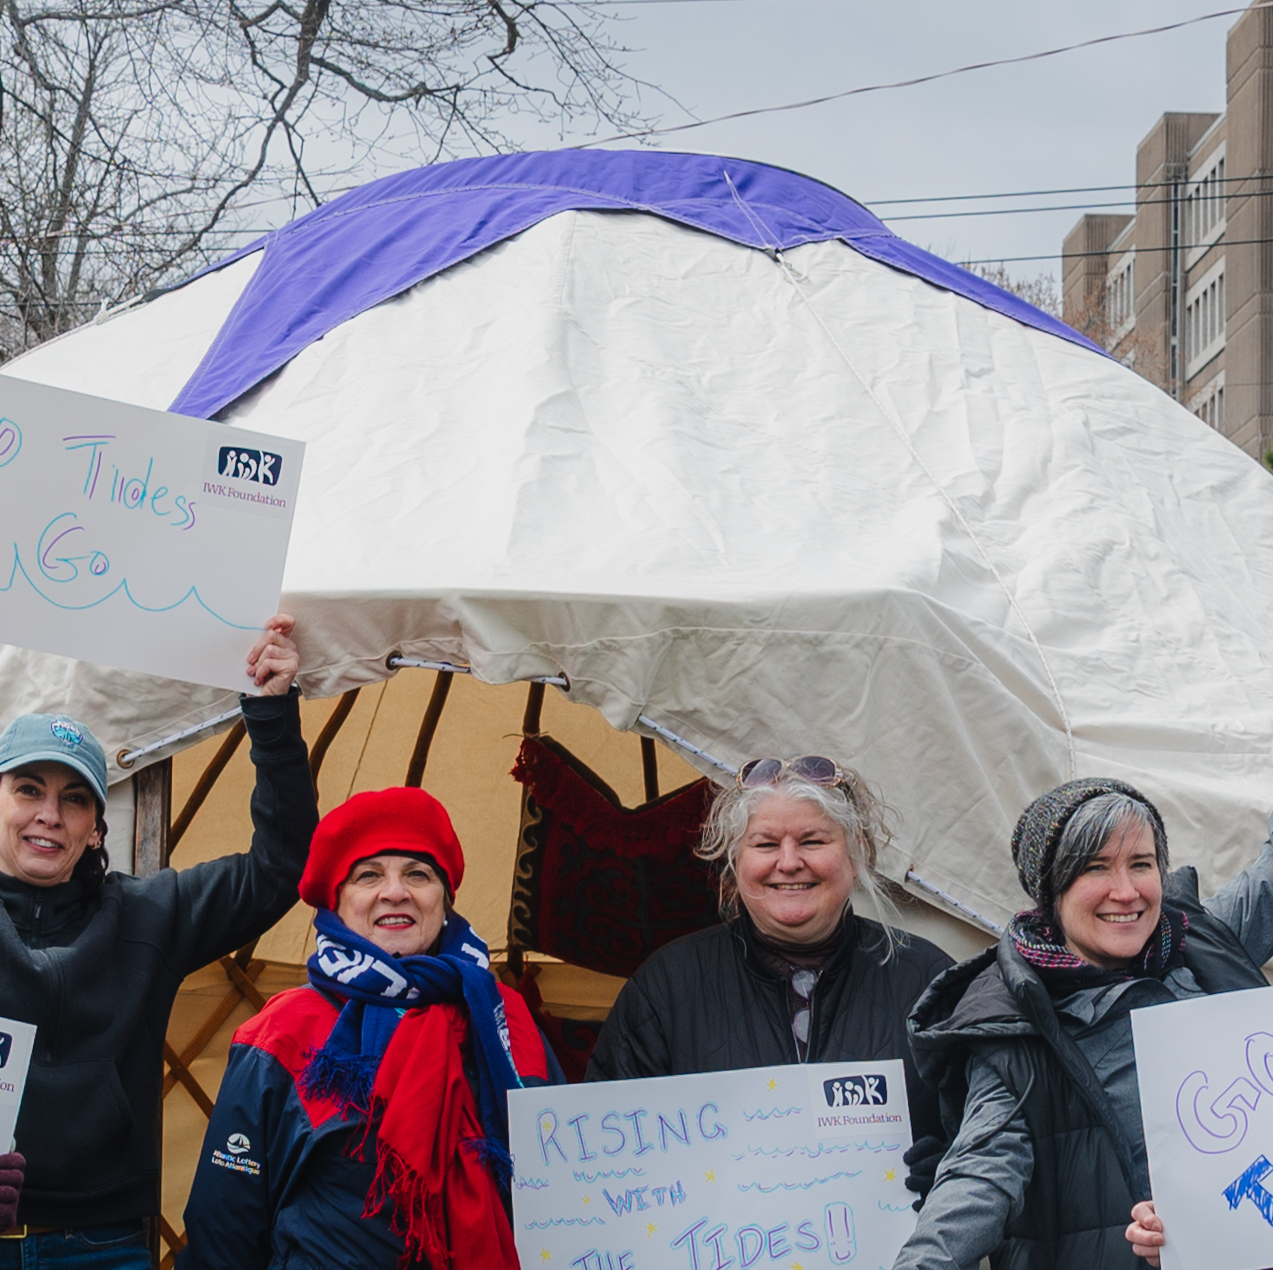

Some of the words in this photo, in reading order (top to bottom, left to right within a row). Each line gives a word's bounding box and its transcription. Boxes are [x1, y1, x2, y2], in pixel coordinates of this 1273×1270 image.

[62, 435, 196, 531] Tides
[202, 482, 227, 497] IWK
[227, 487, 286, 508] Foundation
[537, 1100, 728, 1166] RISING
[817, 1115, 842, 1128] IWK
[842, 1112, 903, 1125] Foundation
[236, 1156, 262, 1169] Lottery
[603, 1180, 687, 1217] WITH
